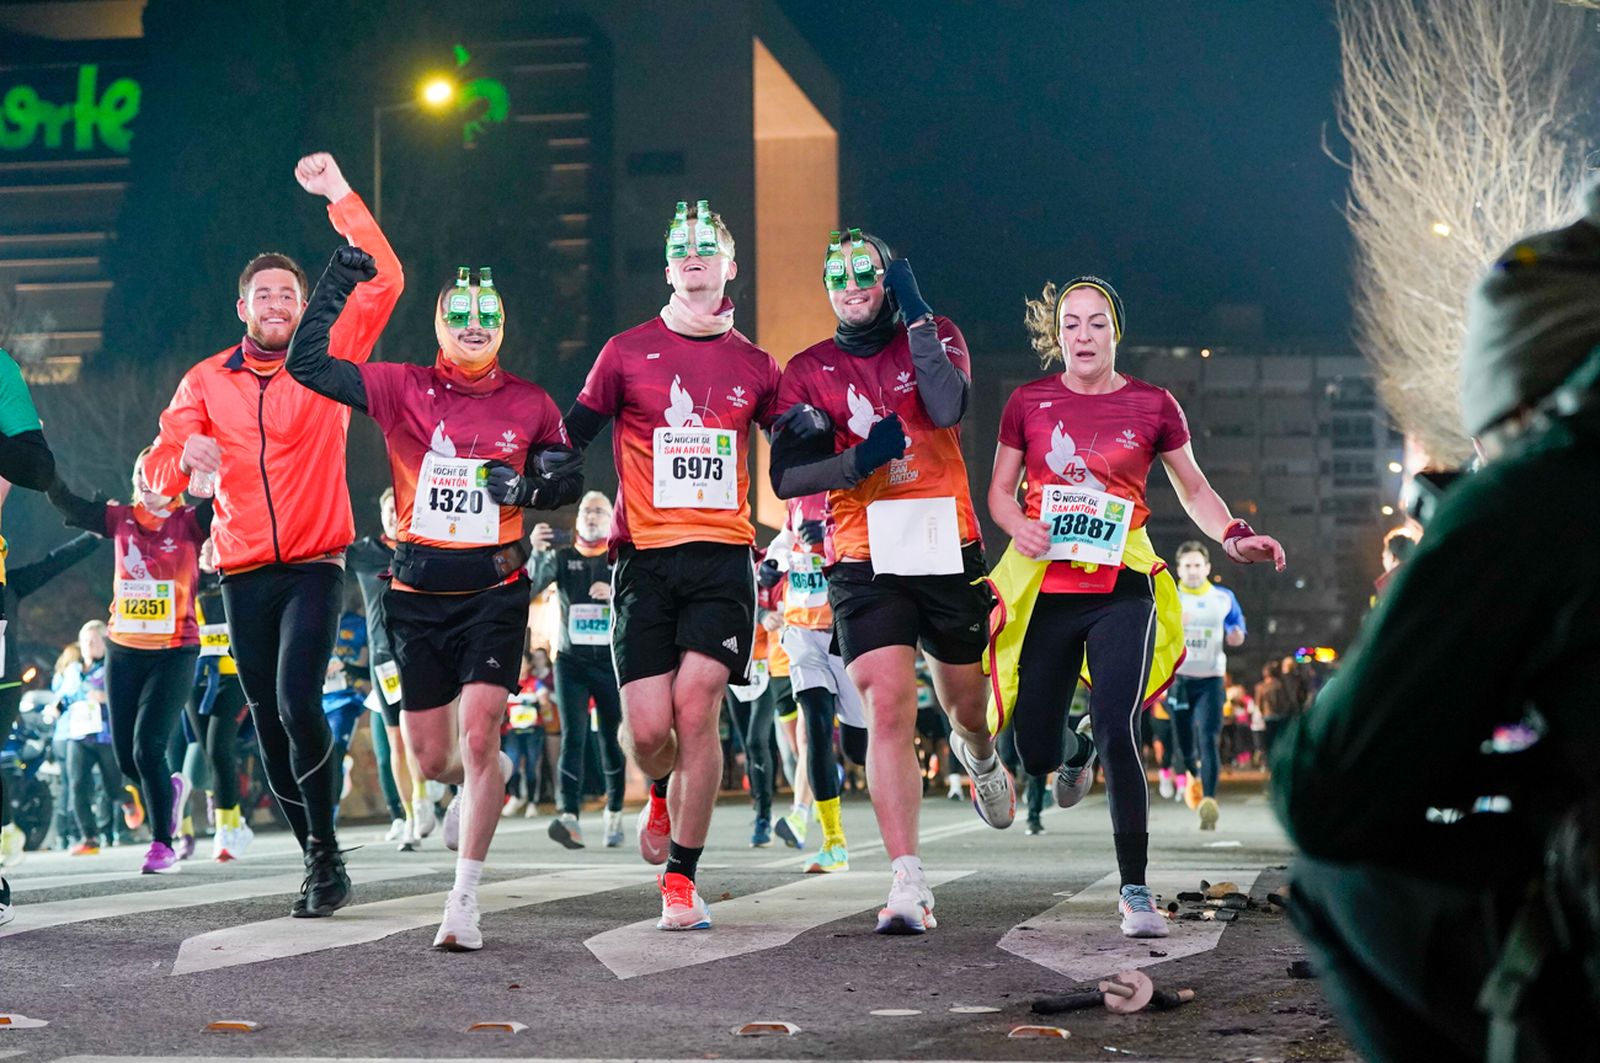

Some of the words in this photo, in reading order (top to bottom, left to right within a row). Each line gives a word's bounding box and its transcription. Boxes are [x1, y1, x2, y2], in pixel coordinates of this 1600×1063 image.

[664, 446, 680, 454] SAN
[672, 456, 724, 481] 6973
[1062, 462, 1086, 483] 43
[428, 487, 484, 514] 4320
[1051, 503, 1069, 513] SAN
[1062, 495, 1087, 503] NOCHE
[1088, 498, 1098, 507] DE
[1052, 513, 1117, 542] 13887
[131, 564, 145, 579] 43
[790, 571, 824, 589] 13647
[124, 600, 166, 615] 12351
